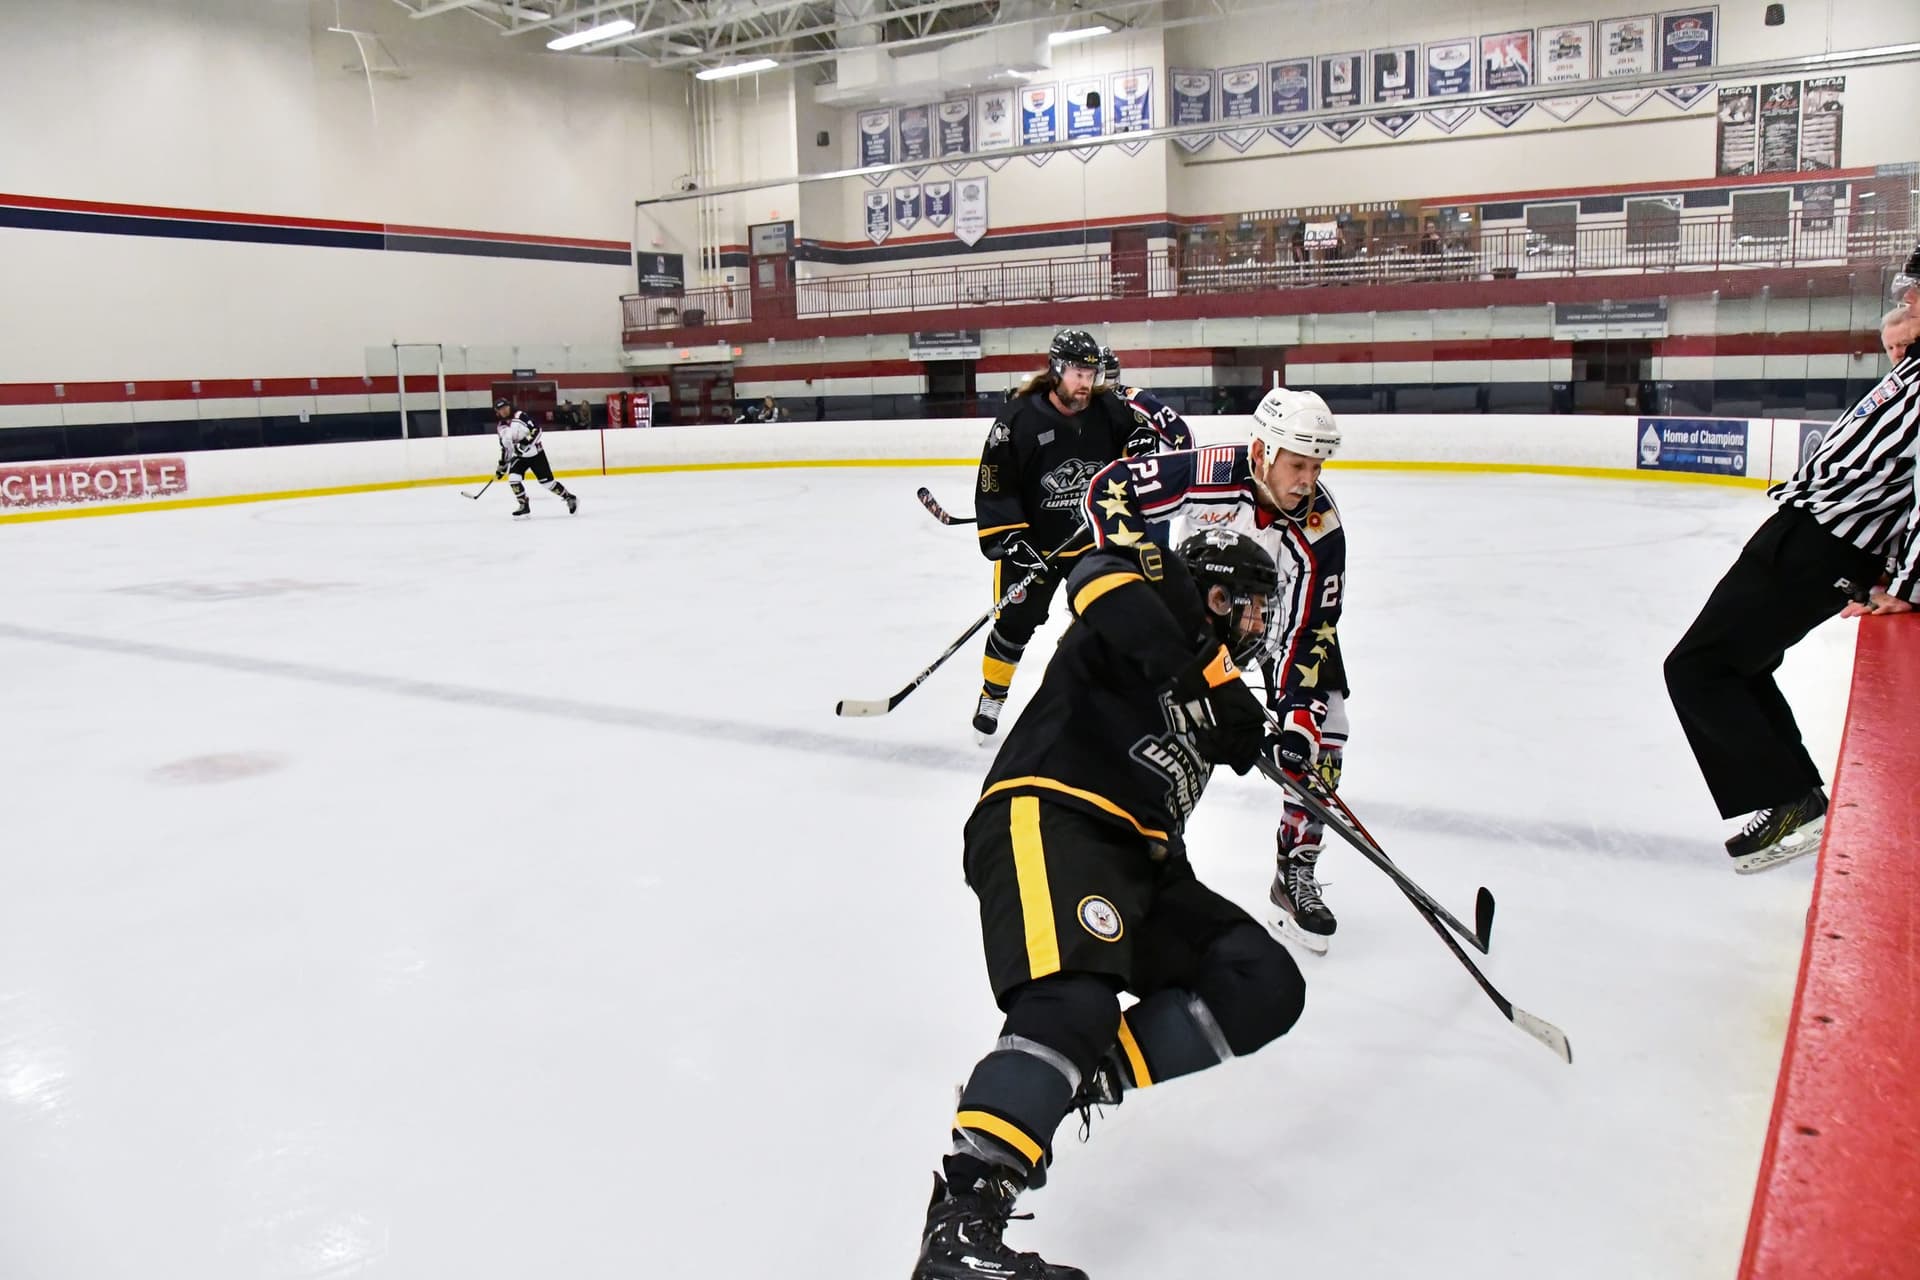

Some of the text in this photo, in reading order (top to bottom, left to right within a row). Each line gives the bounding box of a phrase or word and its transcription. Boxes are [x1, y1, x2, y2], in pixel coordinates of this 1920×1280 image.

[1242, 201, 1399, 221] MINNESOTA WOMEN'S HOCKEY
[1153, 405, 1177, 429] 73
[1664, 429, 1744, 448] Home of Champions
[2, 465, 179, 501] CHIPOTLE
[980, 464, 1000, 493] 35
[1127, 459, 1162, 497] 21
[1046, 498, 1081, 508] WARR
[1054, 492, 1086, 500] PITTS
[1205, 563, 1235, 574] CCM
[1167, 742, 1200, 801] PITTSBU
